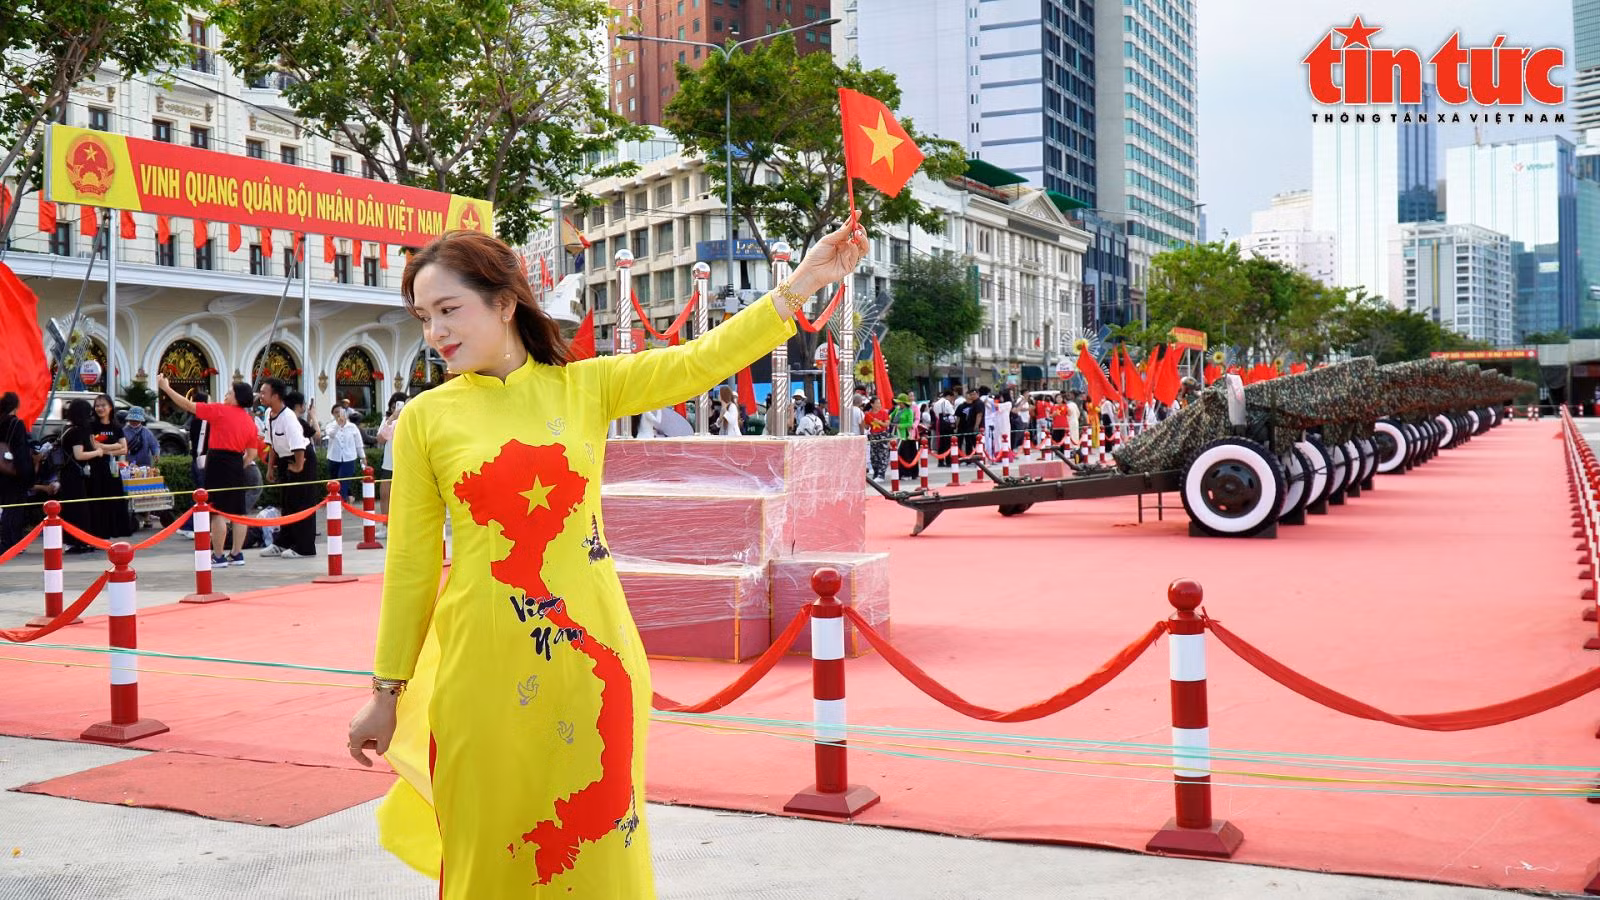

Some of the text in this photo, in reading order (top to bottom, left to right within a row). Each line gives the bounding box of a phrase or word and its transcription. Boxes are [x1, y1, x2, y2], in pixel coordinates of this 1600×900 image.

[140, 163, 443, 236] VINH QUANG QUÂN ĐỘI NHÂN DÂN VIỆT NAM
